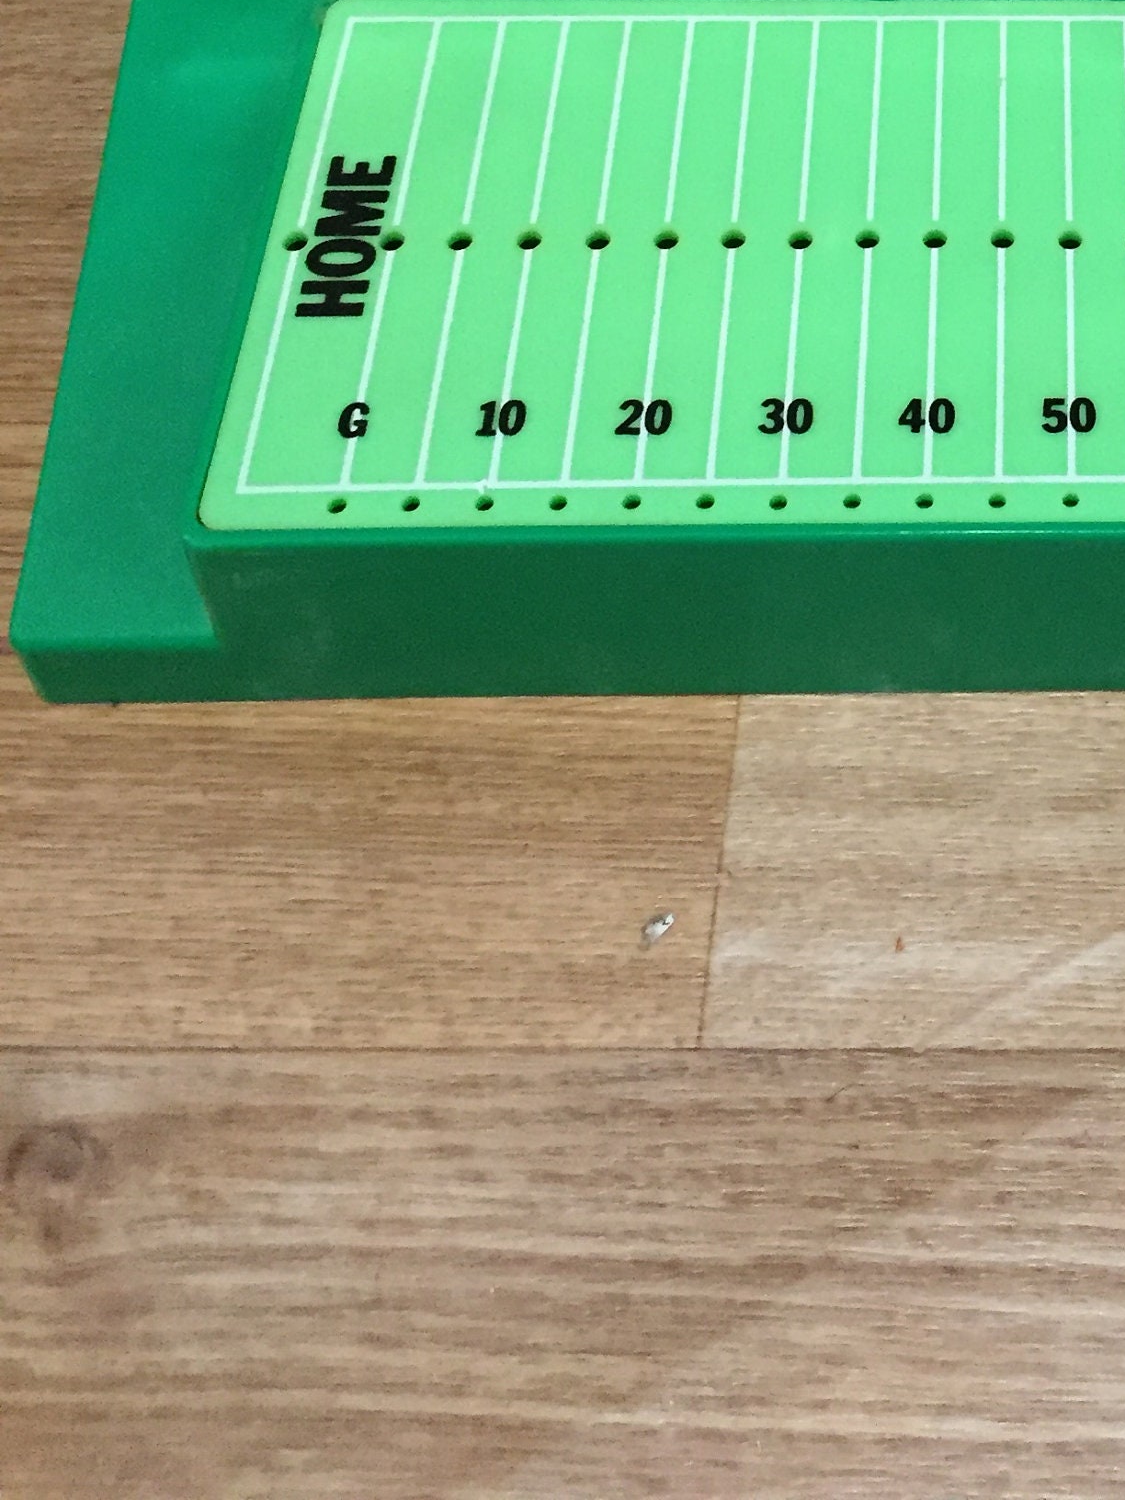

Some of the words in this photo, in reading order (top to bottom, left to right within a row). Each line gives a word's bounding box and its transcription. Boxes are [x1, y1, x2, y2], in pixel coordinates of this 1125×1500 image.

[295, 155, 396, 317] HOME
[337, 402, 370, 438] G
[475, 399, 527, 437] 10
[615, 398, 672, 436] 20
[758, 398, 814, 436] 30
[899, 398, 956, 435] 40
[1041, 397, 1097, 434] 50
